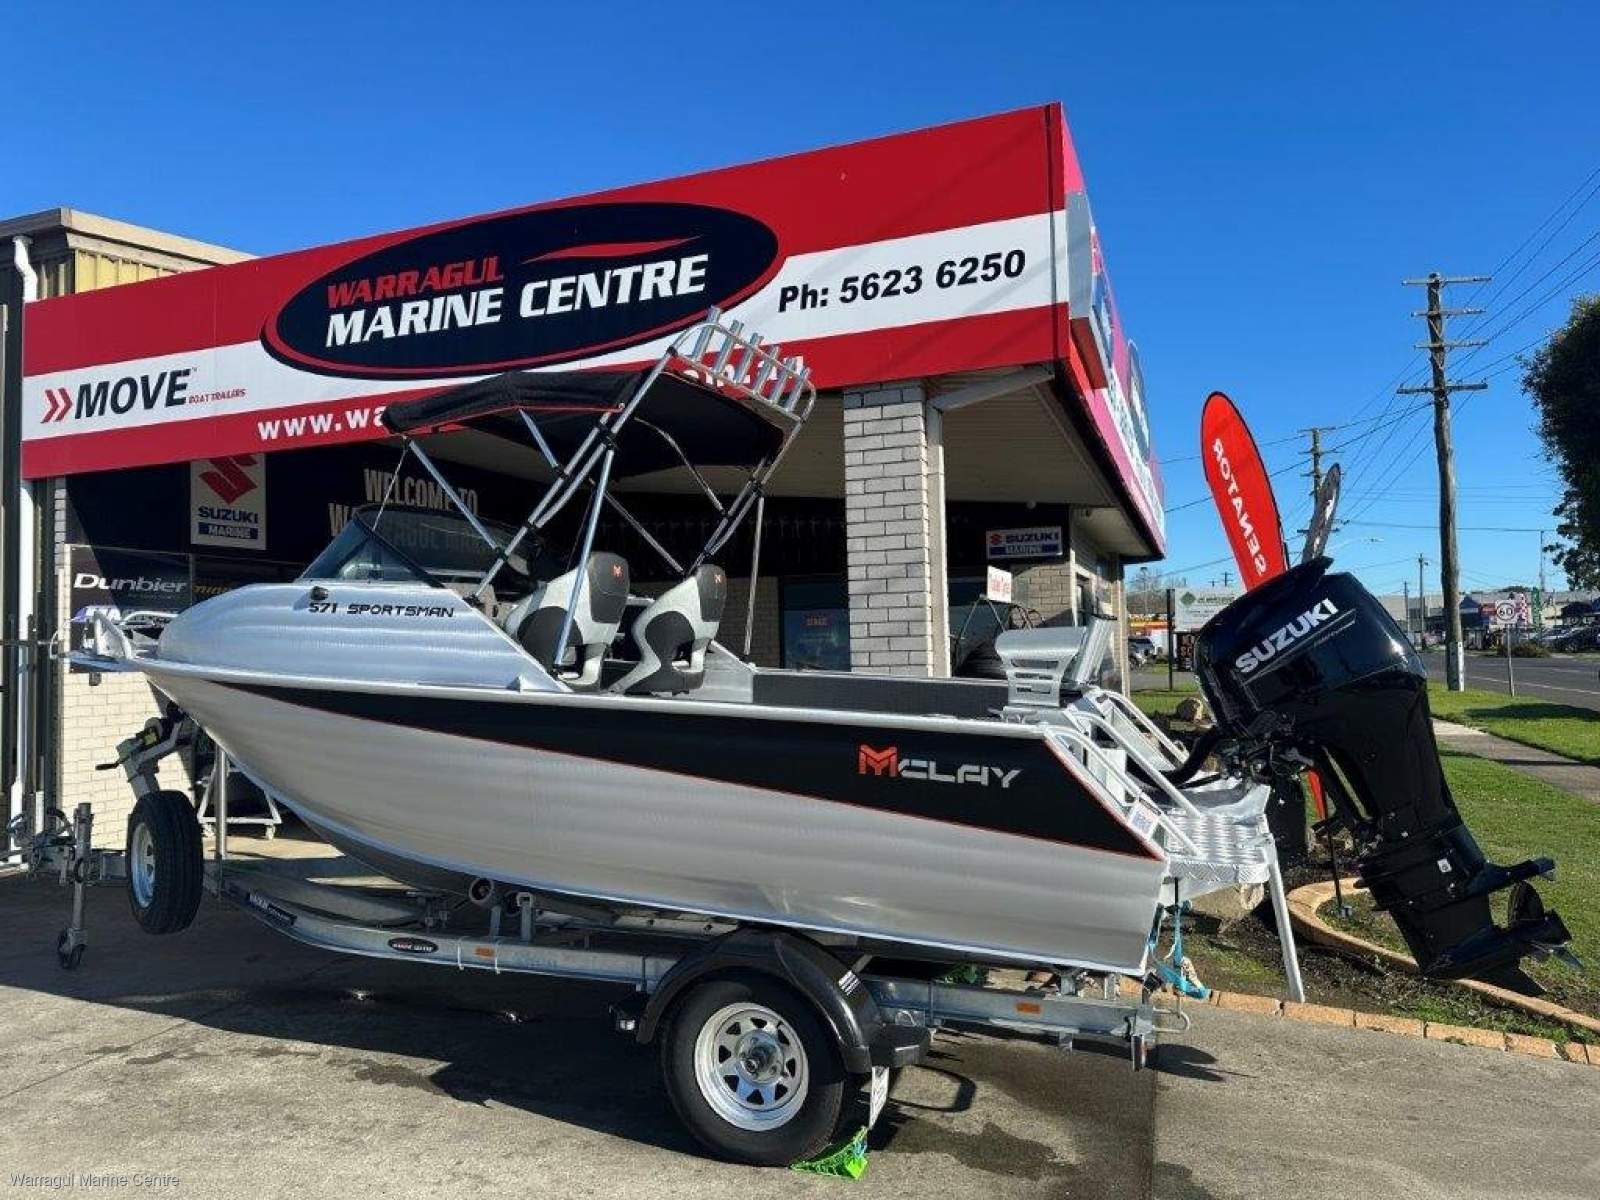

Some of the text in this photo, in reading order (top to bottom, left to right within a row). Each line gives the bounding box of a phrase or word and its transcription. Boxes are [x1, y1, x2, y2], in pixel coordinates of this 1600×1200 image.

[327, 256, 503, 309] WARRAGUL
[778, 249, 1026, 313] Ph: 5623 6250
[326, 254, 709, 347] MARINE CENTRE
[75, 368, 191, 420] MOVE
[198, 505, 259, 523] SUZUKI
[208, 524, 251, 539] MARINE
[1006, 533, 1059, 544] SUZUKI
[73, 573, 187, 593] Dunbier
[308, 602, 455, 618] 571 SPORTSMAN
[1235, 597, 1339, 674] SUZUKI
